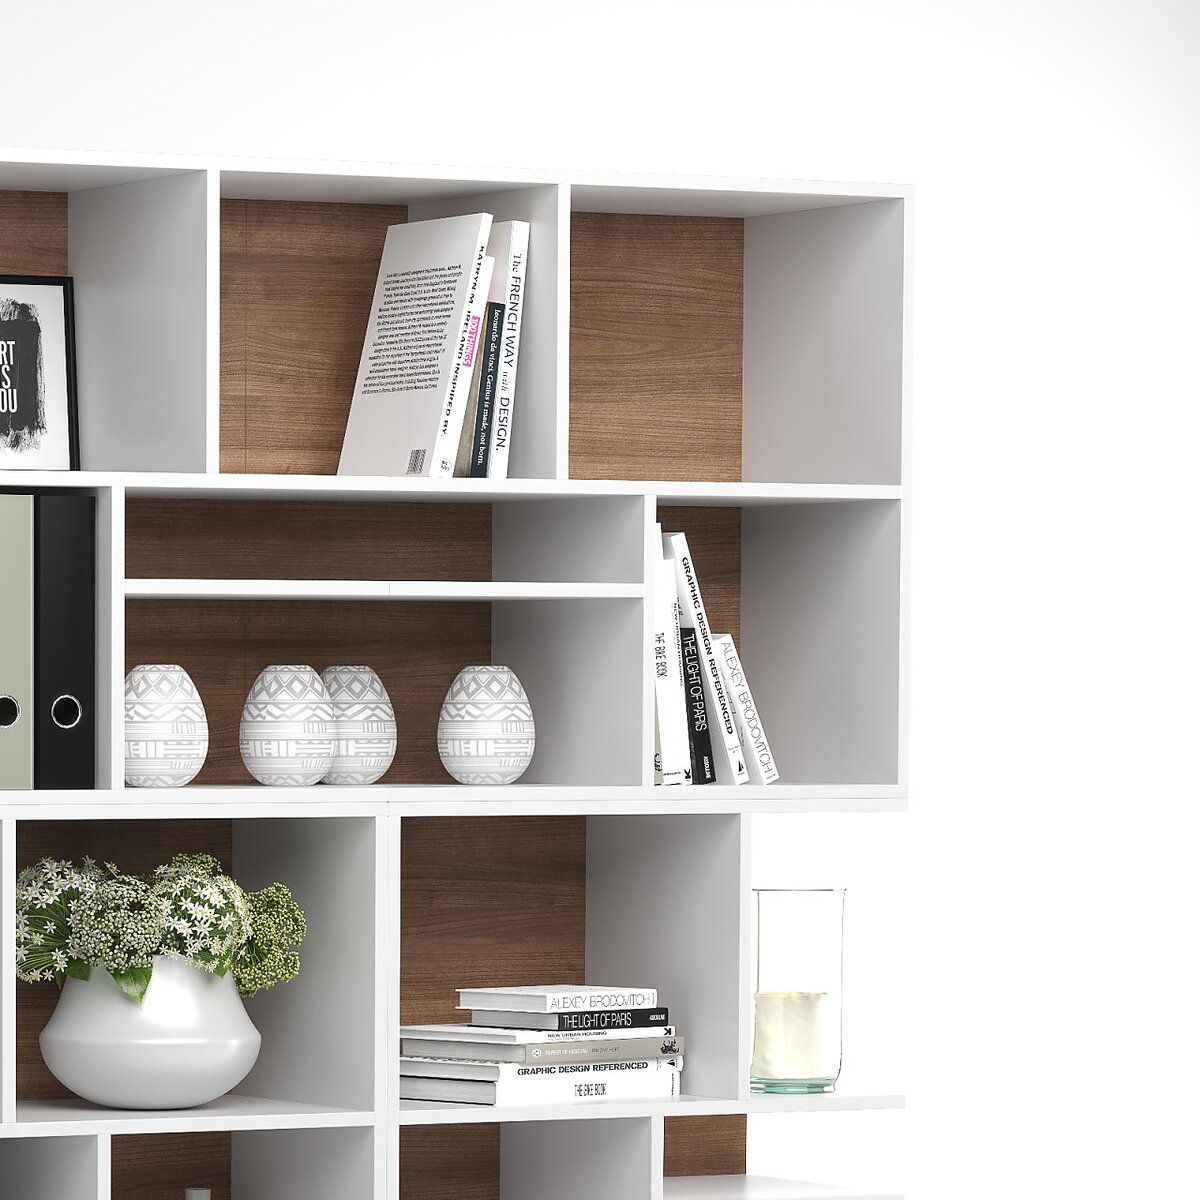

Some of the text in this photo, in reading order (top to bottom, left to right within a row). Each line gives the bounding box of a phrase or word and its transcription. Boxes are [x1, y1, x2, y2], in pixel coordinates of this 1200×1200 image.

[512, 253, 522, 273] The
[507, 276, 521, 331] FRENCH
[457, 311, 471, 360] IRELAND
[462, 318, 479, 367] 100 THINGS
[490, 342, 498, 352] da
[503, 336, 517, 368] WAY
[445, 363, 461, 416] INSPIRED
[484, 374, 494, 401] Genius
[495, 397, 510, 451] DESIGN.
[654, 632, 665, 643] THE
[681, 557, 700, 608] GRAPHIC
[695, 613, 713, 655] DESIGN
[708, 659, 734, 733] REFERENCED
[656, 661, 668, 677] BOOK
[682, 633, 706, 731] THE LIGHT OF PARIS
[721, 641, 773, 773] ALEXEY BRODOVITCH
[550, 993, 651, 1010] ALEXEY BRODOVITCH
[563, 1012, 632, 1029] THE LIGHT OF PARIS
[517, 1066, 557, 1076] GRAPHIC
[558, 1065, 591, 1074] DESIGN
[592, 1061, 649, 1072] REFERENCED
[574, 1084, 583, 1097] THE
[594, 1083, 607, 1096] BOOK
